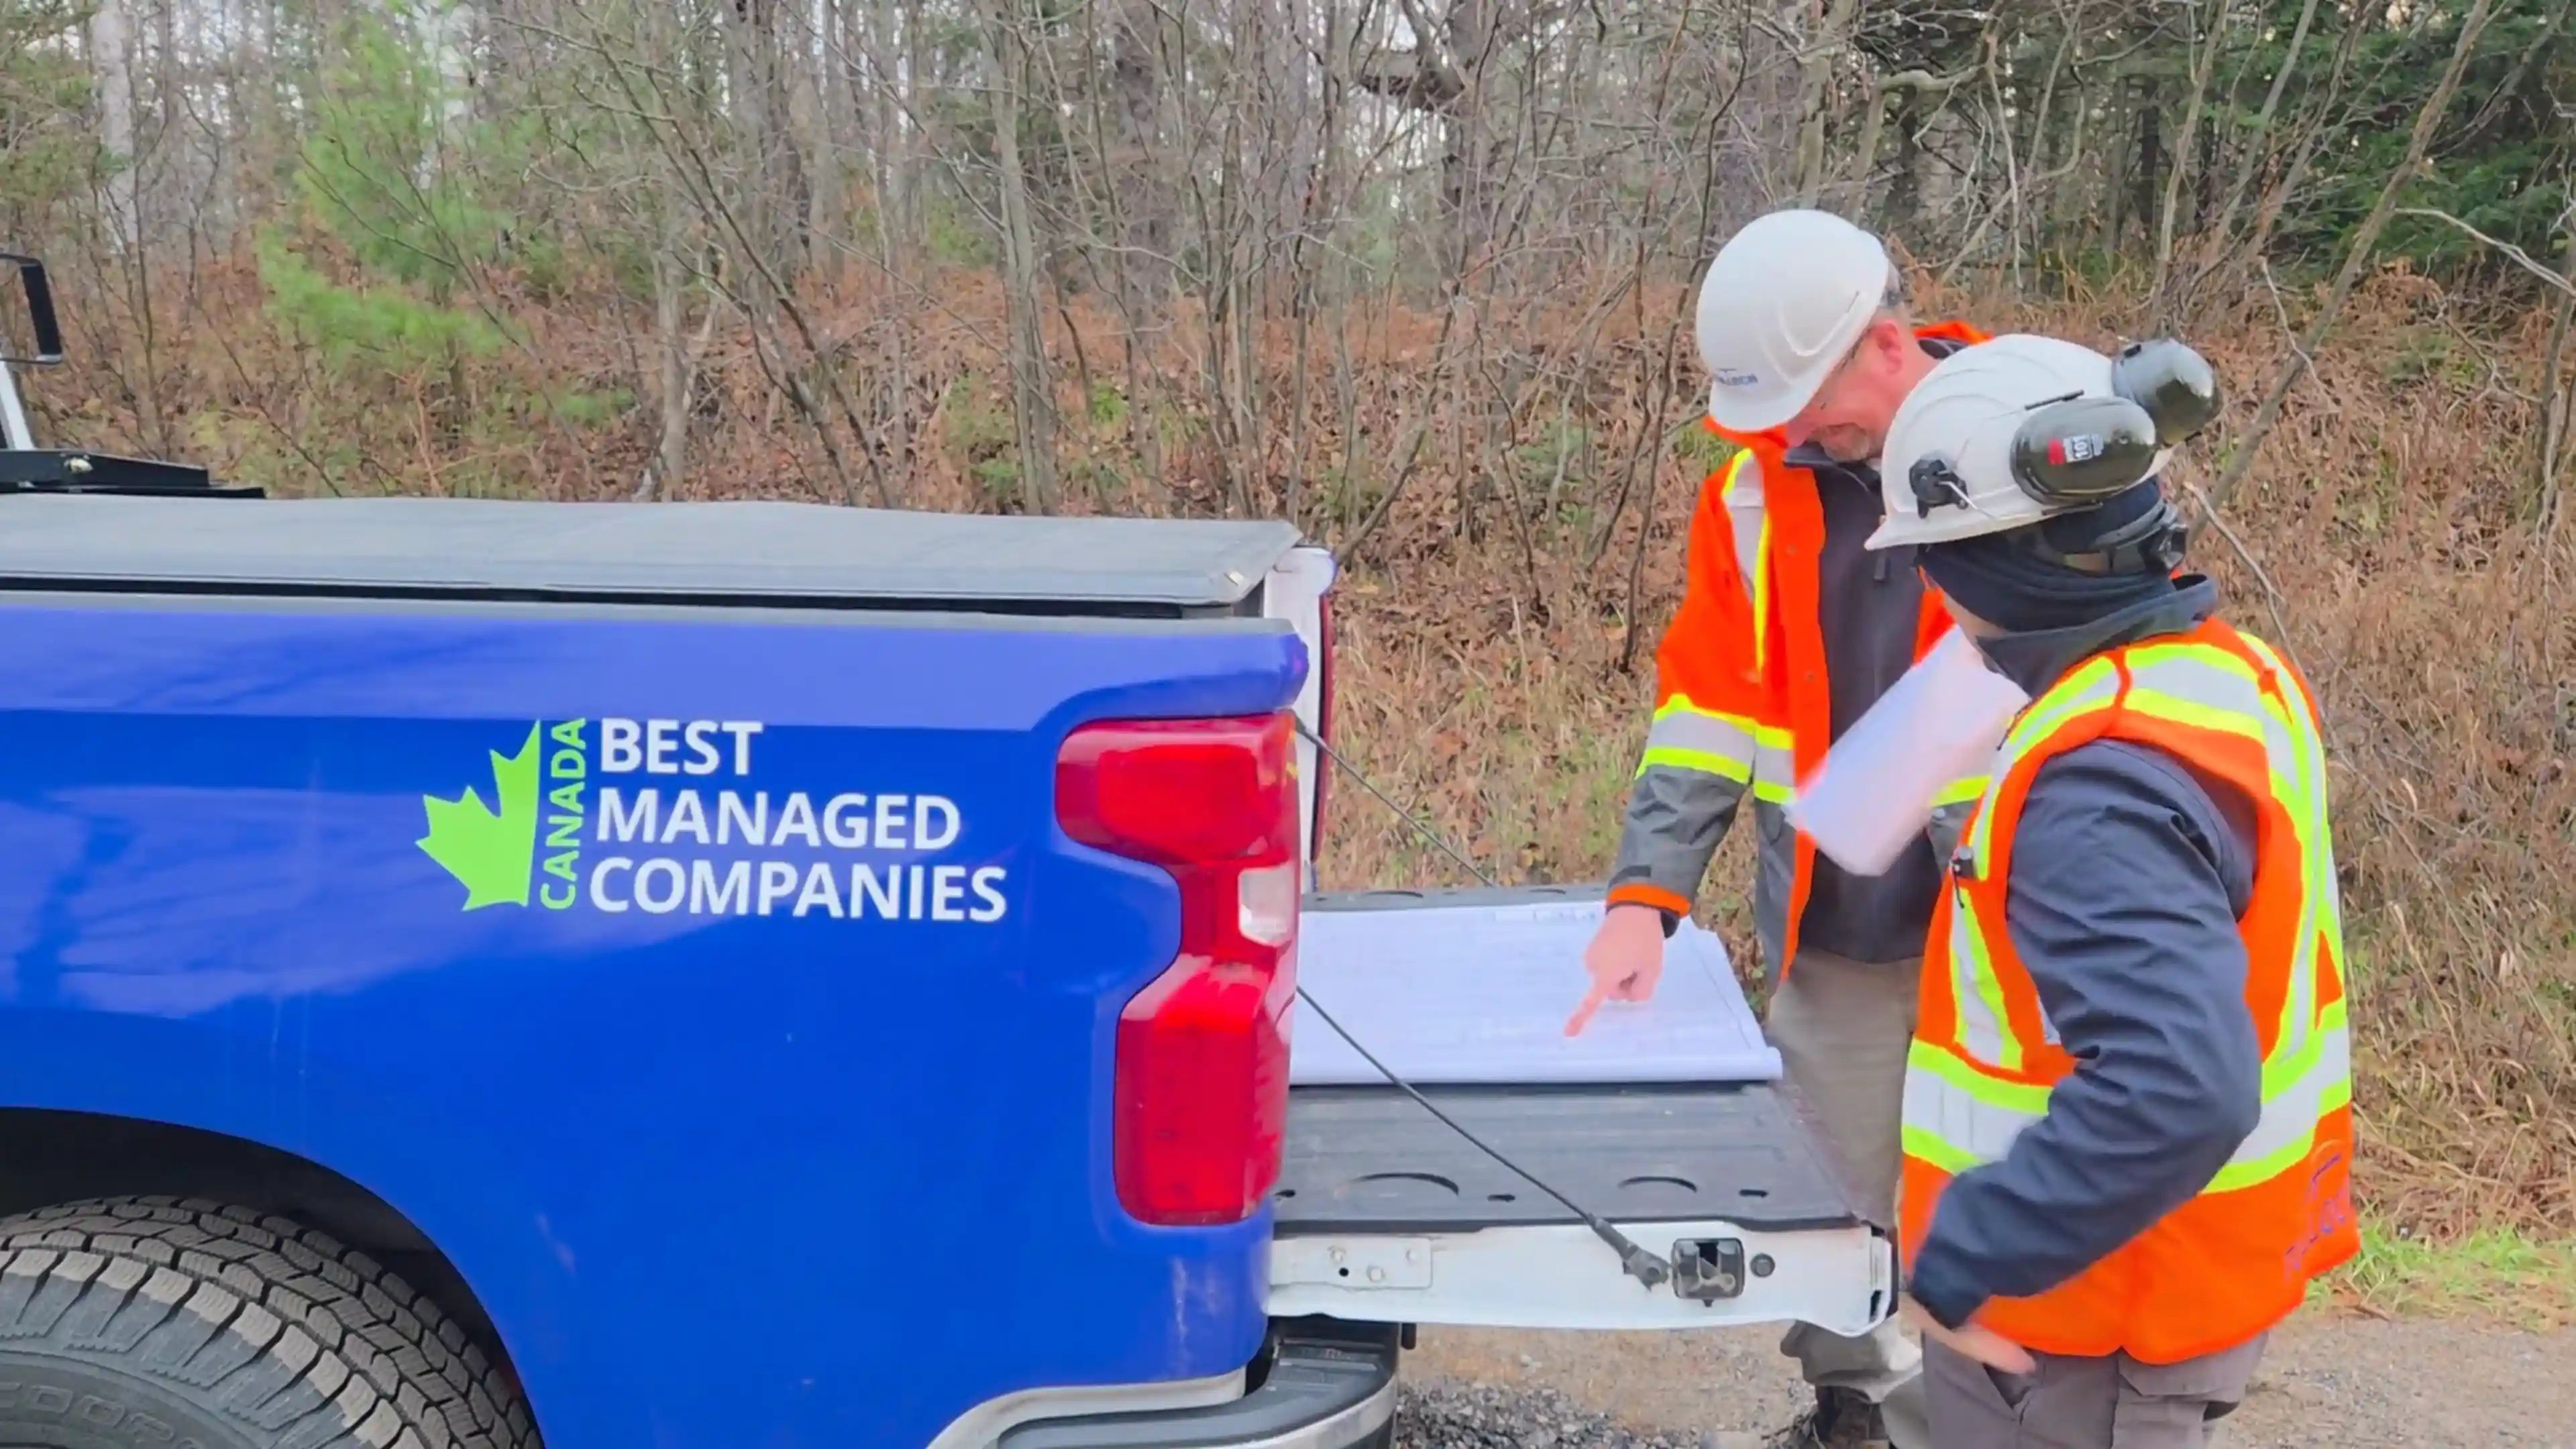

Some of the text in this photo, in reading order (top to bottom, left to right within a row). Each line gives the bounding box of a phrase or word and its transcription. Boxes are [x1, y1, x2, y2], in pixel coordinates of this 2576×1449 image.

[602, 718, 762, 775] BEST
[541, 718, 585, 909] CANADA
[597, 788, 960, 850] MANAGED
[590, 857, 1006, 922] COMPANIES
